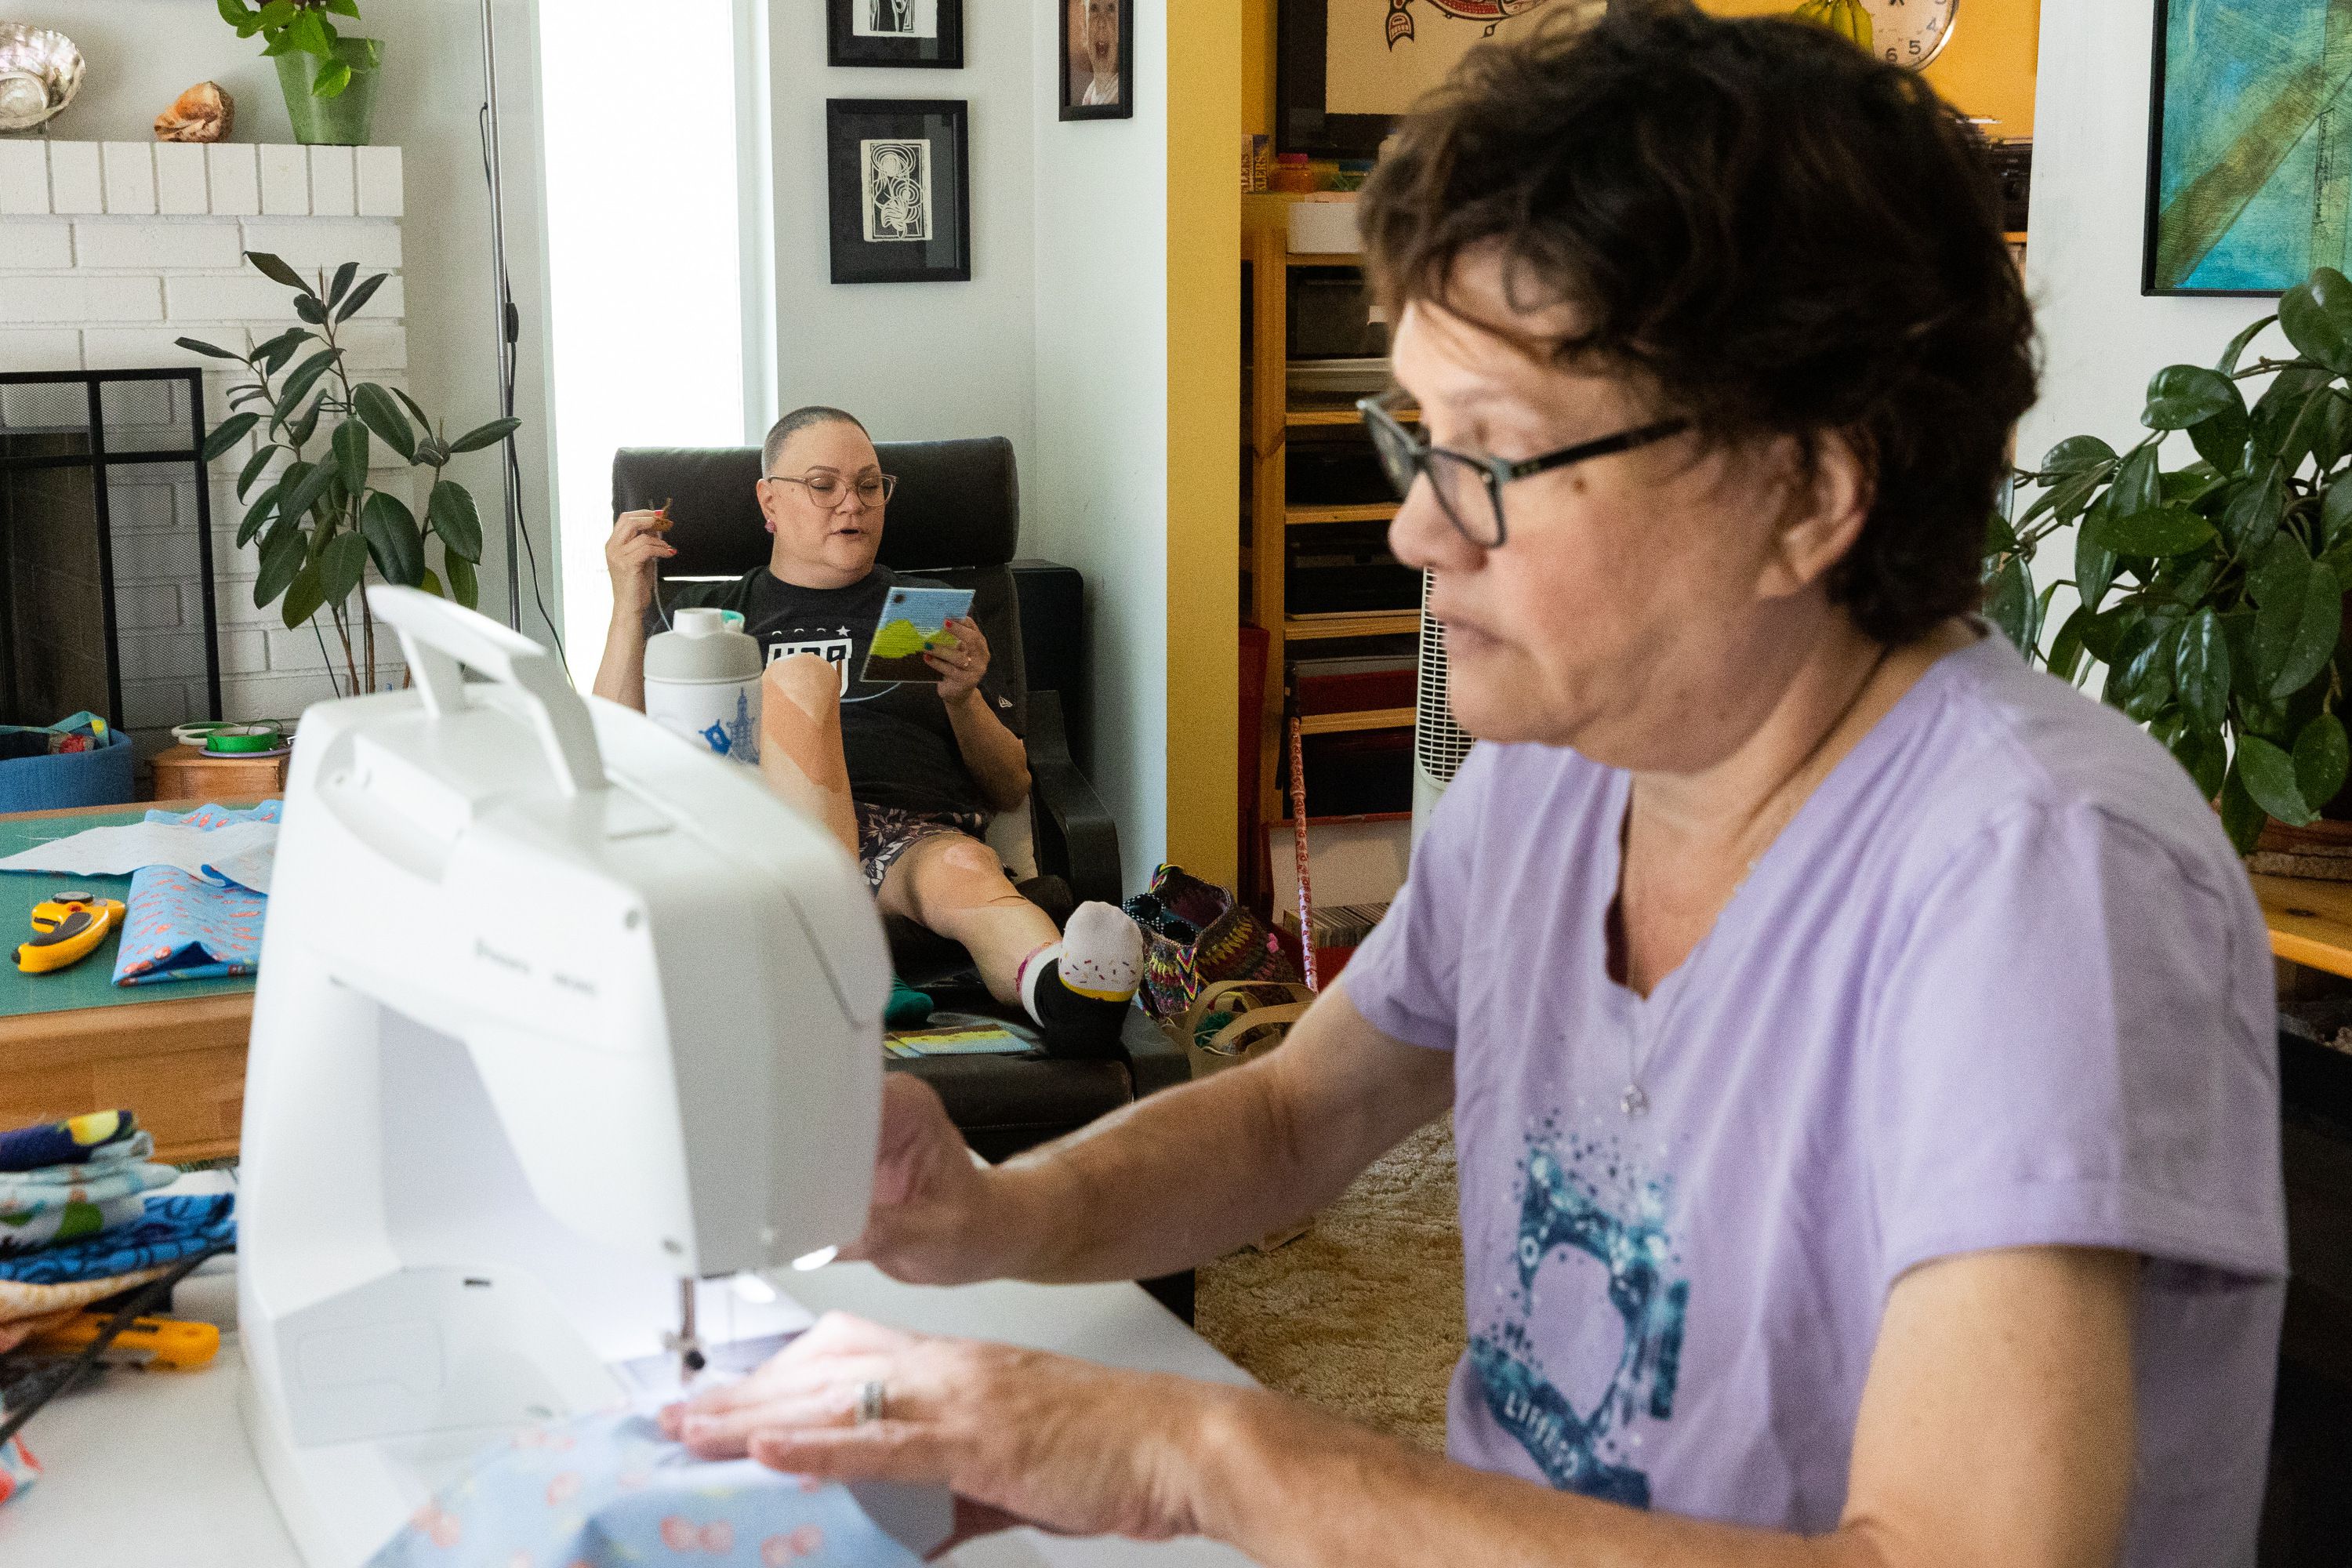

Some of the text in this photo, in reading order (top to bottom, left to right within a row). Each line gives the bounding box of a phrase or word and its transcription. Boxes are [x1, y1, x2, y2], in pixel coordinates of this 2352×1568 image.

[1926, 17, 1937, 32] 4
[1886, 47, 1897, 62] 6
[1908, 40, 1921, 55] 5
